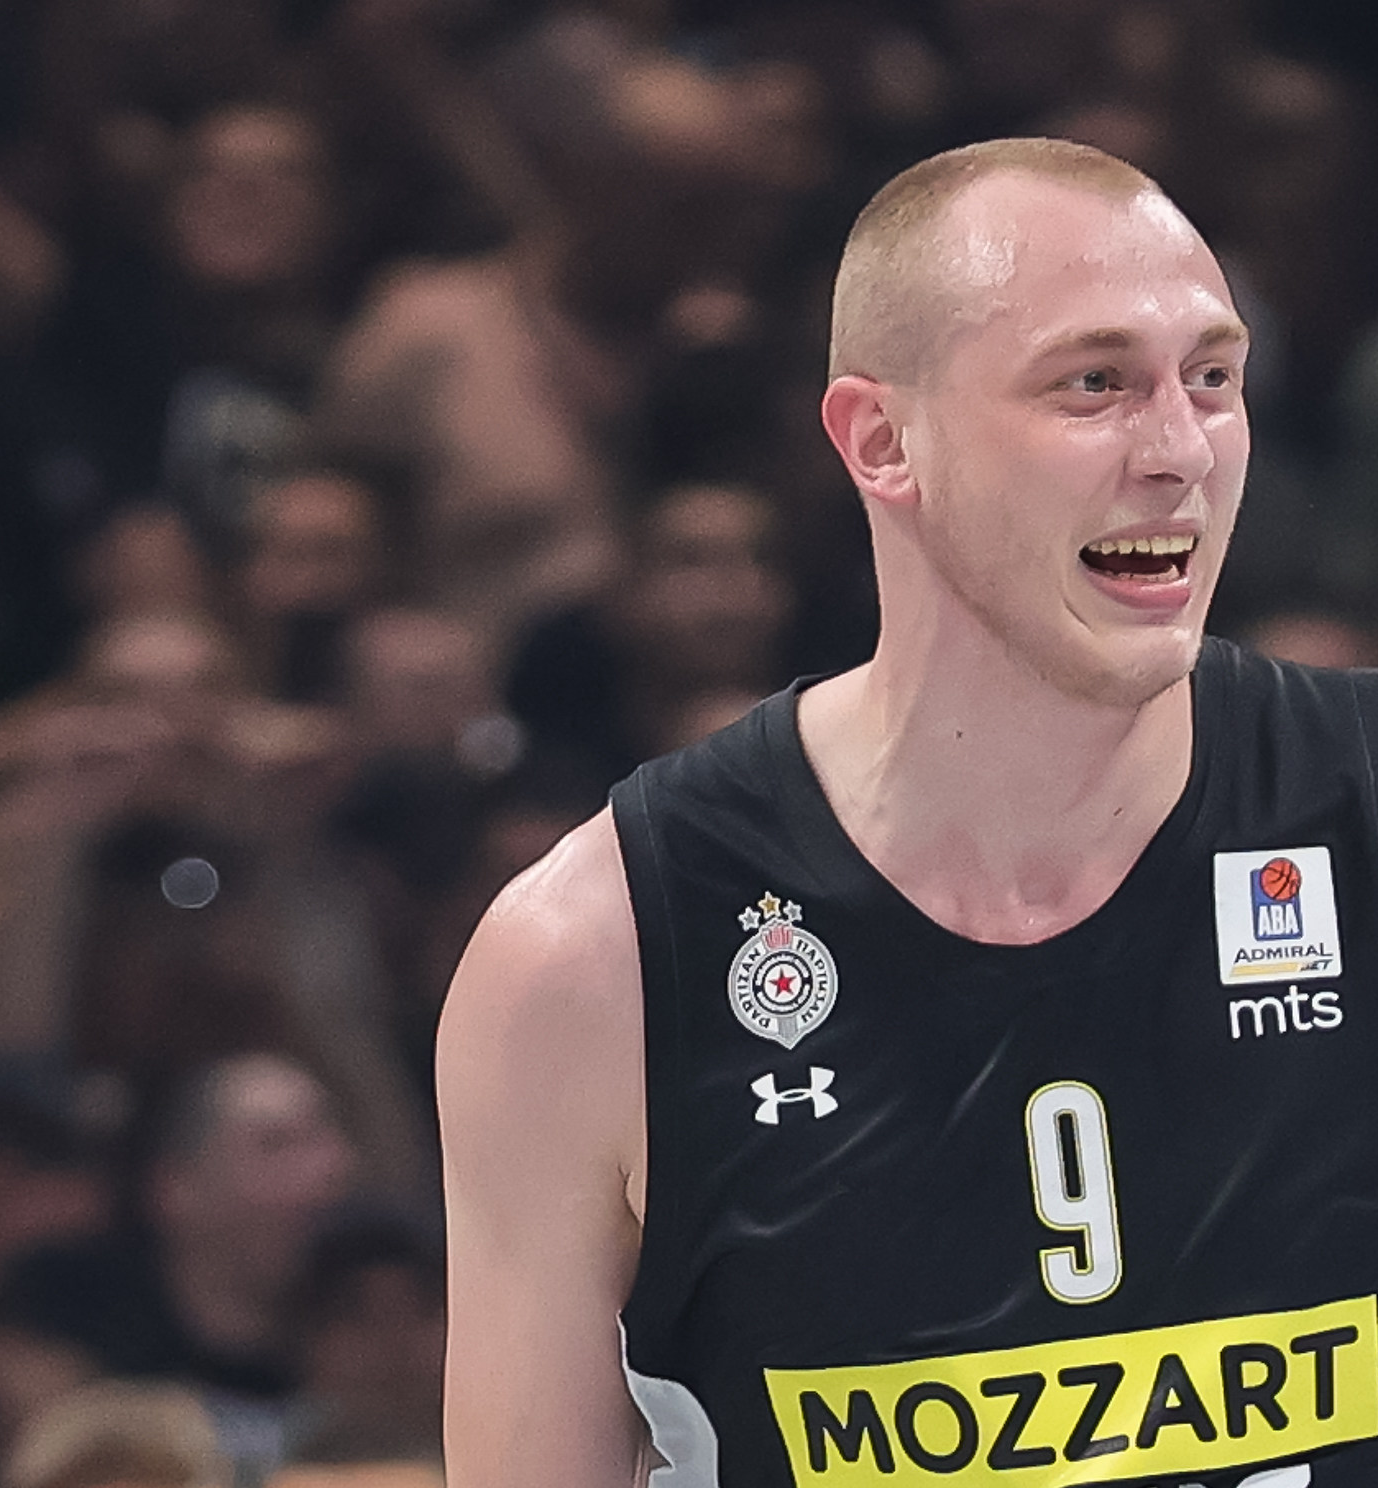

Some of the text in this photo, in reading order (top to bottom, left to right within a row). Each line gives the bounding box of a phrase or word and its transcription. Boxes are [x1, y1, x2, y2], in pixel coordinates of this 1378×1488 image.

[1258, 904, 1300, 937] ABA
[1234, 942, 1333, 963] ADMIRAL
[1229, 985, 1343, 1039] mts
[1024, 1081, 1122, 1304] 9
[798, 1325, 1359, 1474] MOZZART
